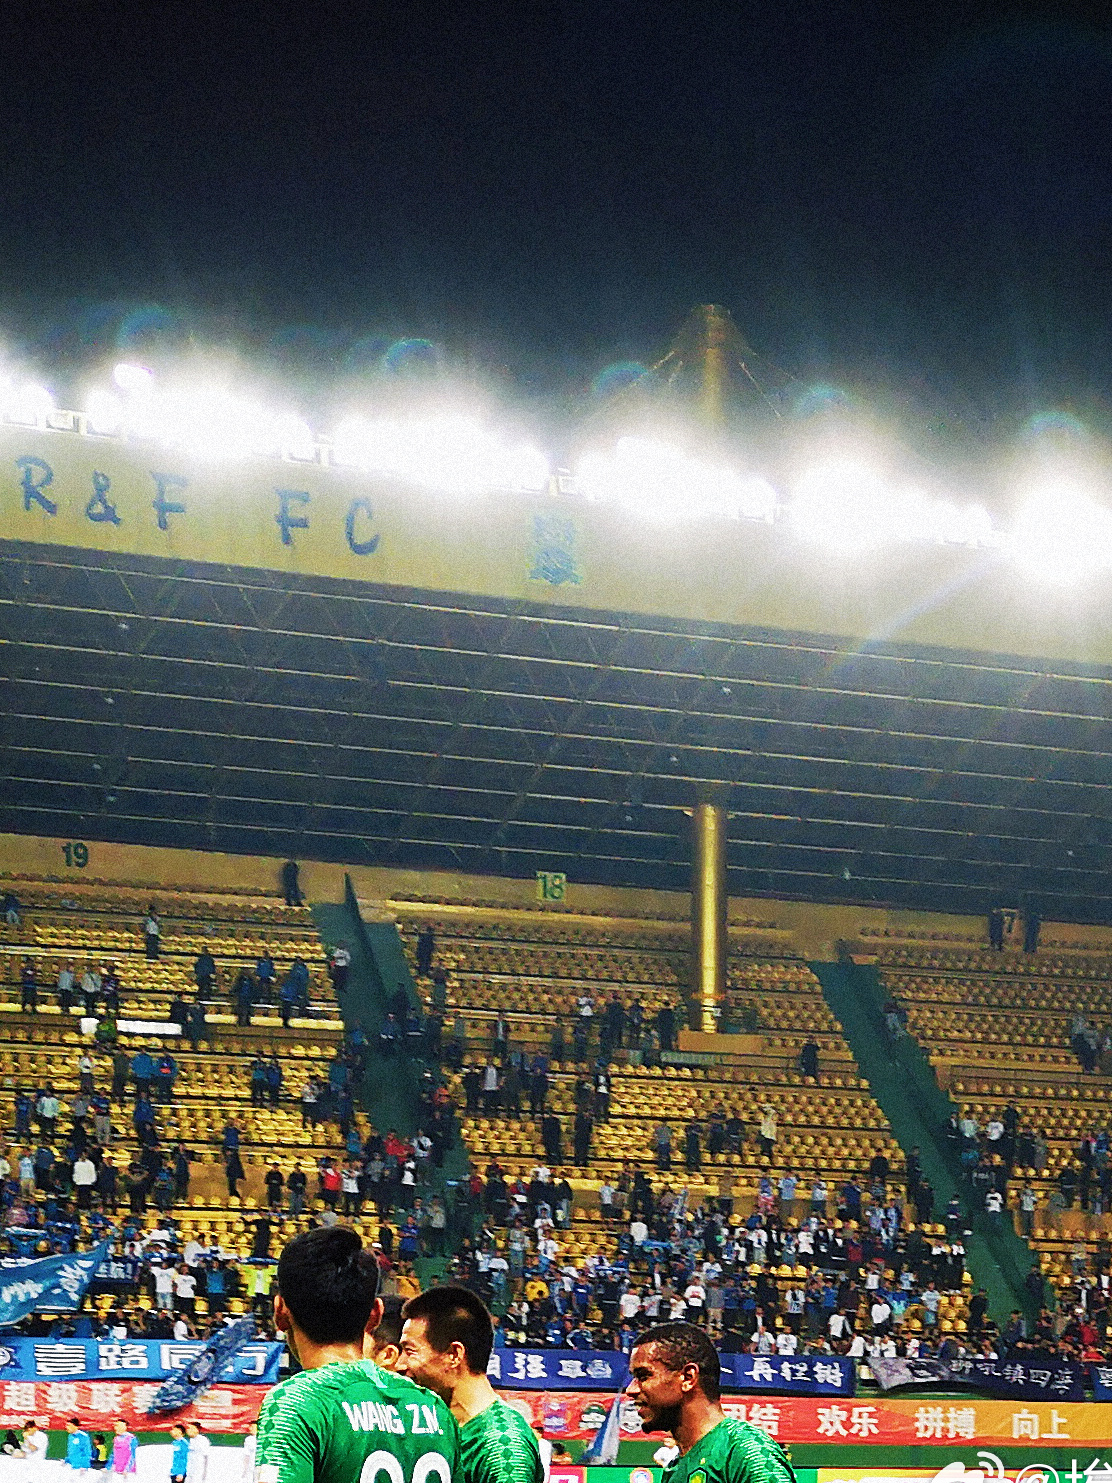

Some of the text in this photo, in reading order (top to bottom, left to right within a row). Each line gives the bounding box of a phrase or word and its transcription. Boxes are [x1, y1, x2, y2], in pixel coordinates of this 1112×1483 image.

[273, 486, 381, 556] FC
[61, 842, 89, 868] 19
[541, 874, 564, 900] 18
[341, 1401, 405, 1434] WANG
[816, 1405, 880, 1437] 欢乐
[914, 1406, 976, 1439] 拼搏
[1012, 1409, 1071, 1440] 向上
